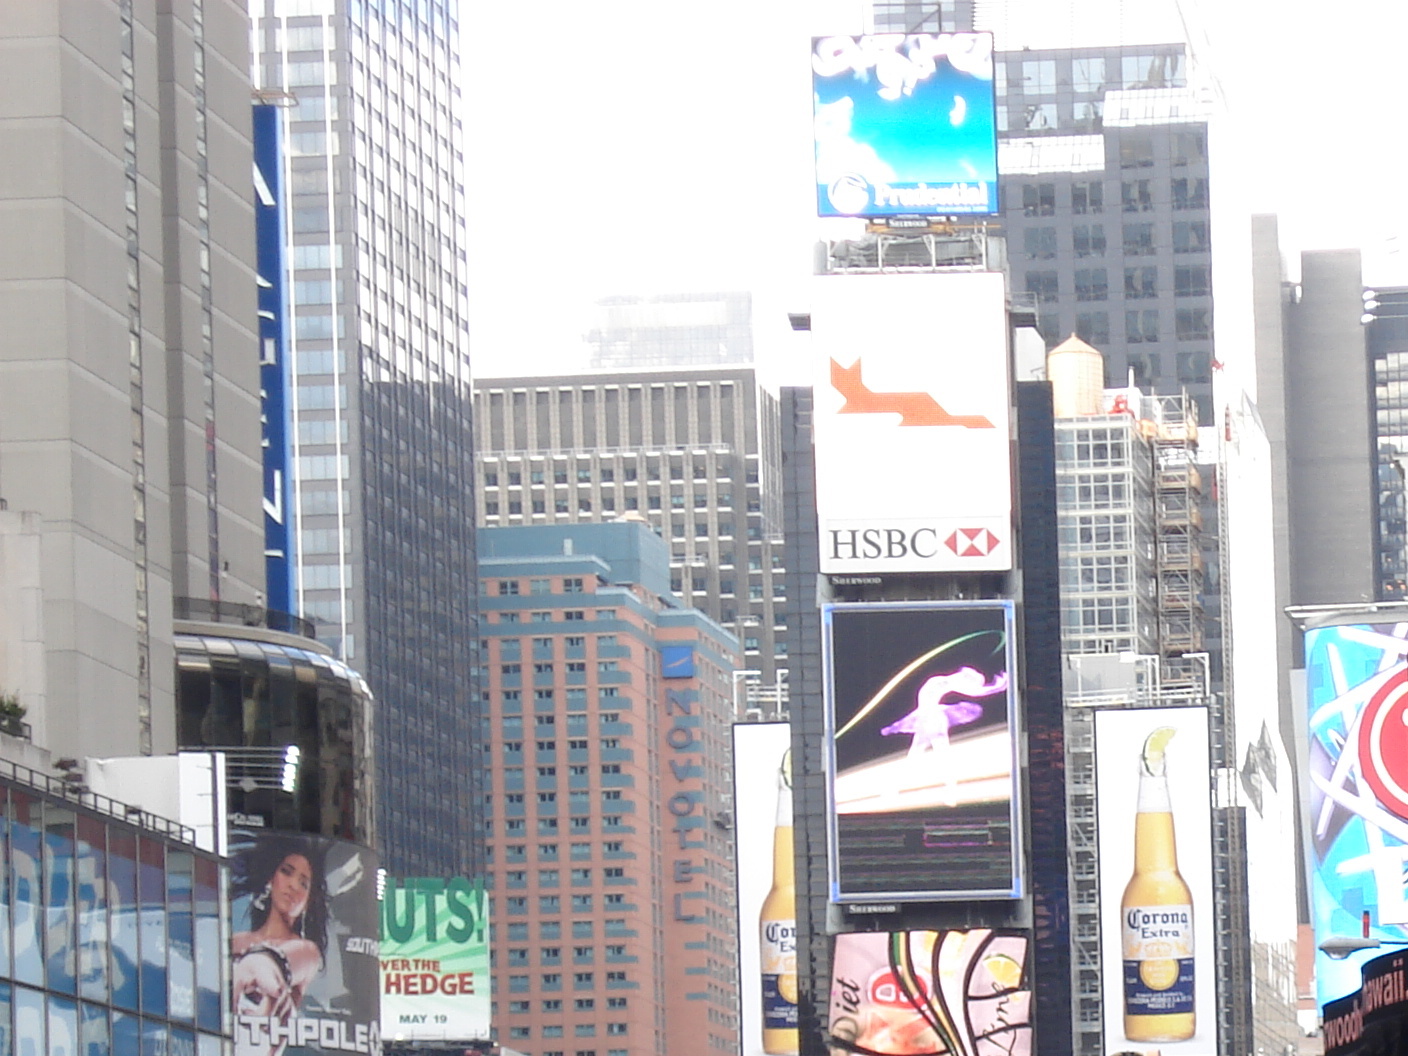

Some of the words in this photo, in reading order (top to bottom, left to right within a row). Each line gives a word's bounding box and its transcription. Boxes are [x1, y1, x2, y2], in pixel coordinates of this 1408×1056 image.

[829, 528, 938, 560] HSBC
[665, 687, 695, 921] NOVOTEL
[1127, 908, 1188, 931] Corona
[1141, 928, 1180, 938] Extra
[380, 958, 411, 972] VER
[414, 959, 441, 973] THE
[384, 972, 476, 996] HEDGE
[399, 1015, 427, 1025] MAY
[433, 1015, 448, 1024] 19
[832, 975, 861, 1042] Diet
